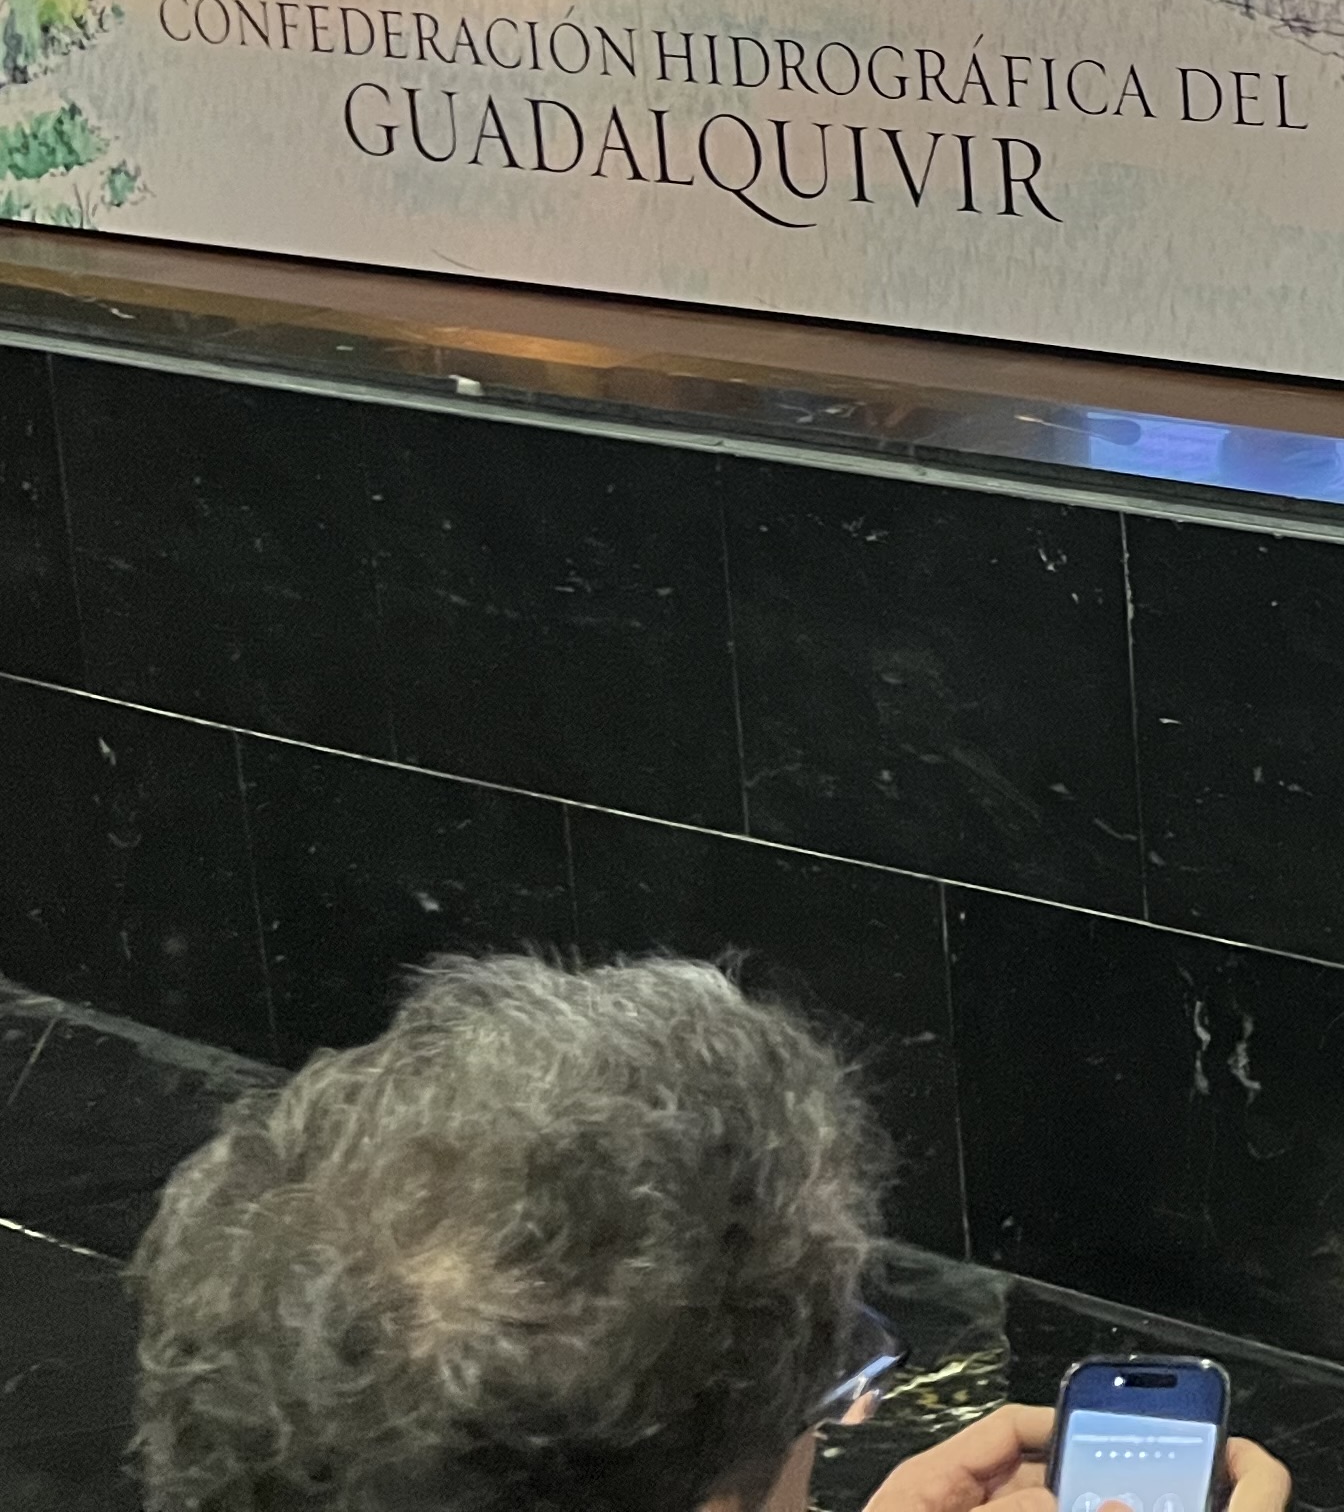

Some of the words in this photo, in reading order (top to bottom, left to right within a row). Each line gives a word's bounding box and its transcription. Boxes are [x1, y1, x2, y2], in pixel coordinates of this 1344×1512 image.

[651, 29, 1158, 119] HIDROGRÁFICA
[1176, 66, 1309, 130] DEL
[343, 82, 1064, 228] GUADALQUIVIR
